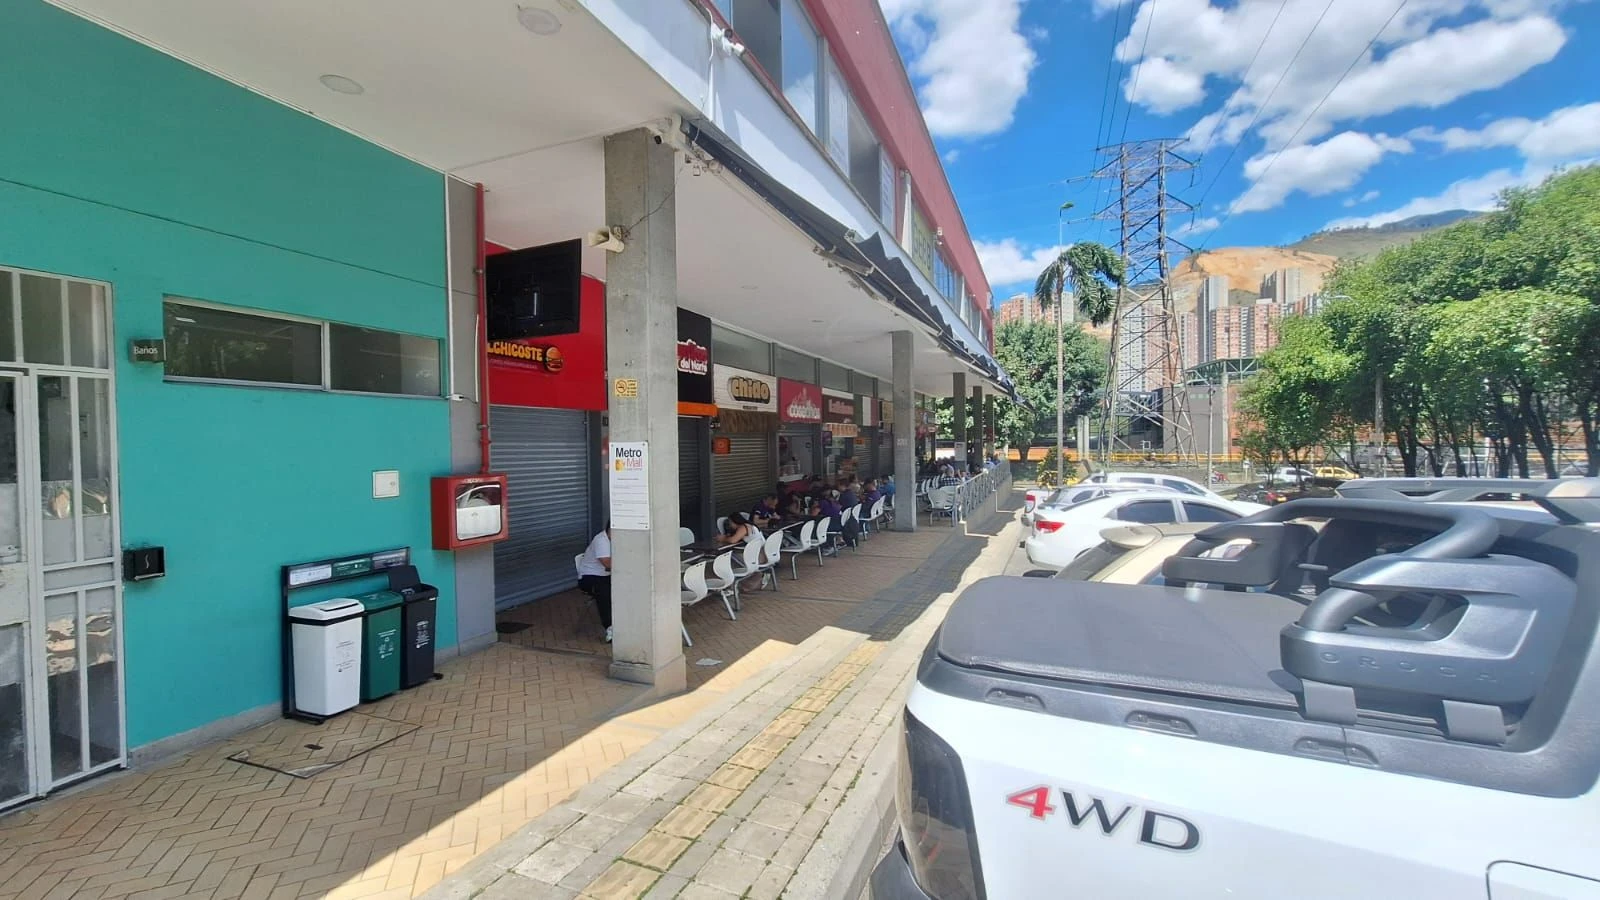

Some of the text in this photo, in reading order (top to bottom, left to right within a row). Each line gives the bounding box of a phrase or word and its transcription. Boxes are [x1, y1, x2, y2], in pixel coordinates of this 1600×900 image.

[615, 447, 642, 458] Metro
[626, 458, 643, 468] Mall
[1006, 785, 1200, 851] 4WD
